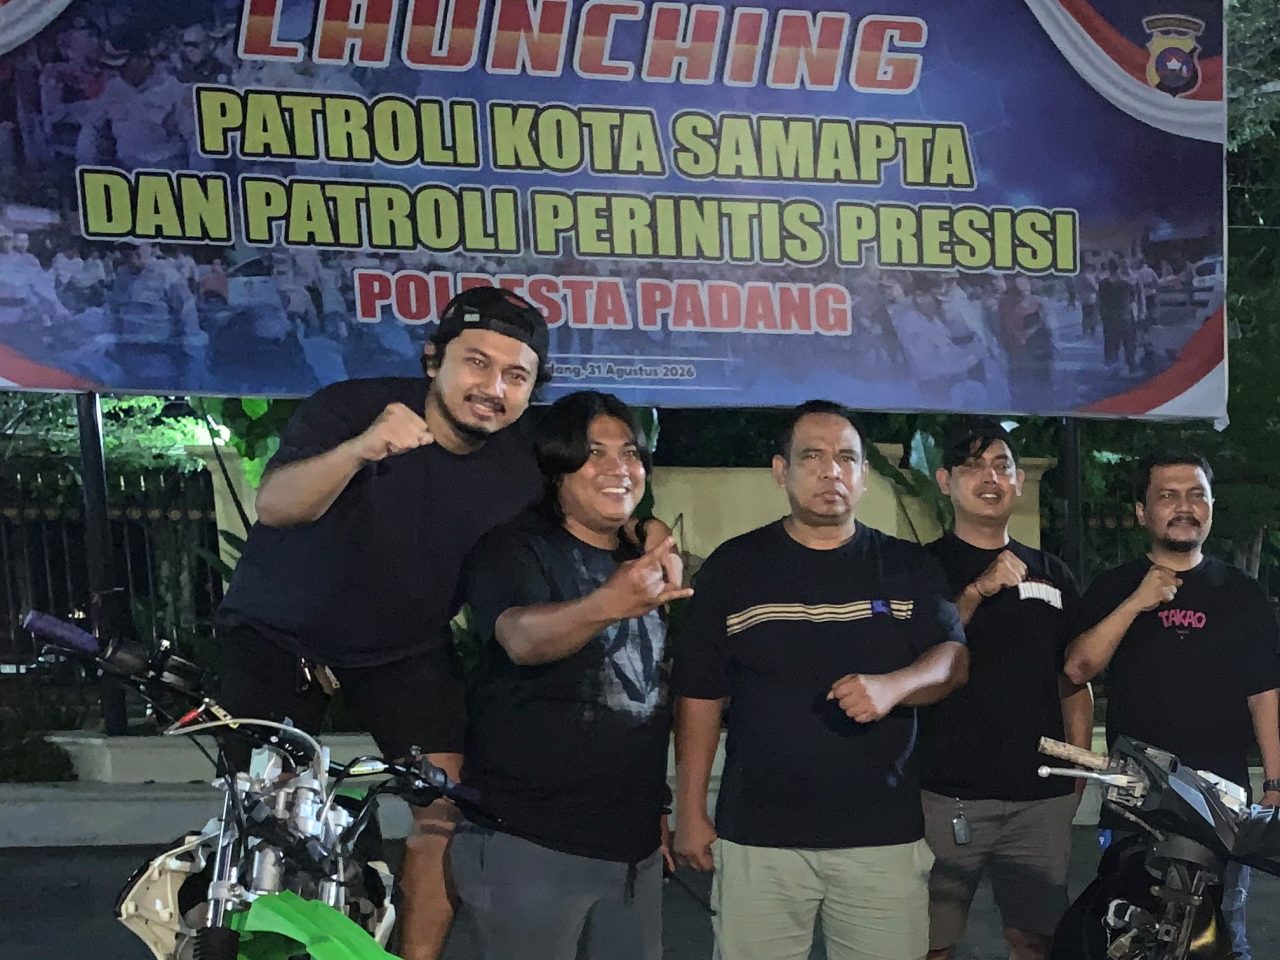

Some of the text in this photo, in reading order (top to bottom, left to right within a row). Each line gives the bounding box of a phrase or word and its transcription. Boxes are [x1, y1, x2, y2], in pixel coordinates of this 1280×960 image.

[237, 0, 927, 94] LAUNCHING
[196, 85, 976, 190] PATROLI KOTA SAMAPTA
[78, 167, 1080, 275] DAN PATROLI PERINTIS PRESISI
[355, 270, 851, 335] POLSTA PADANG
[588, 363, 602, 377] 31
[605, 363, 659, 379] Agustus
[662, 365, 696, 379] 2026
[1158, 609, 1206, 628] TAKAO
